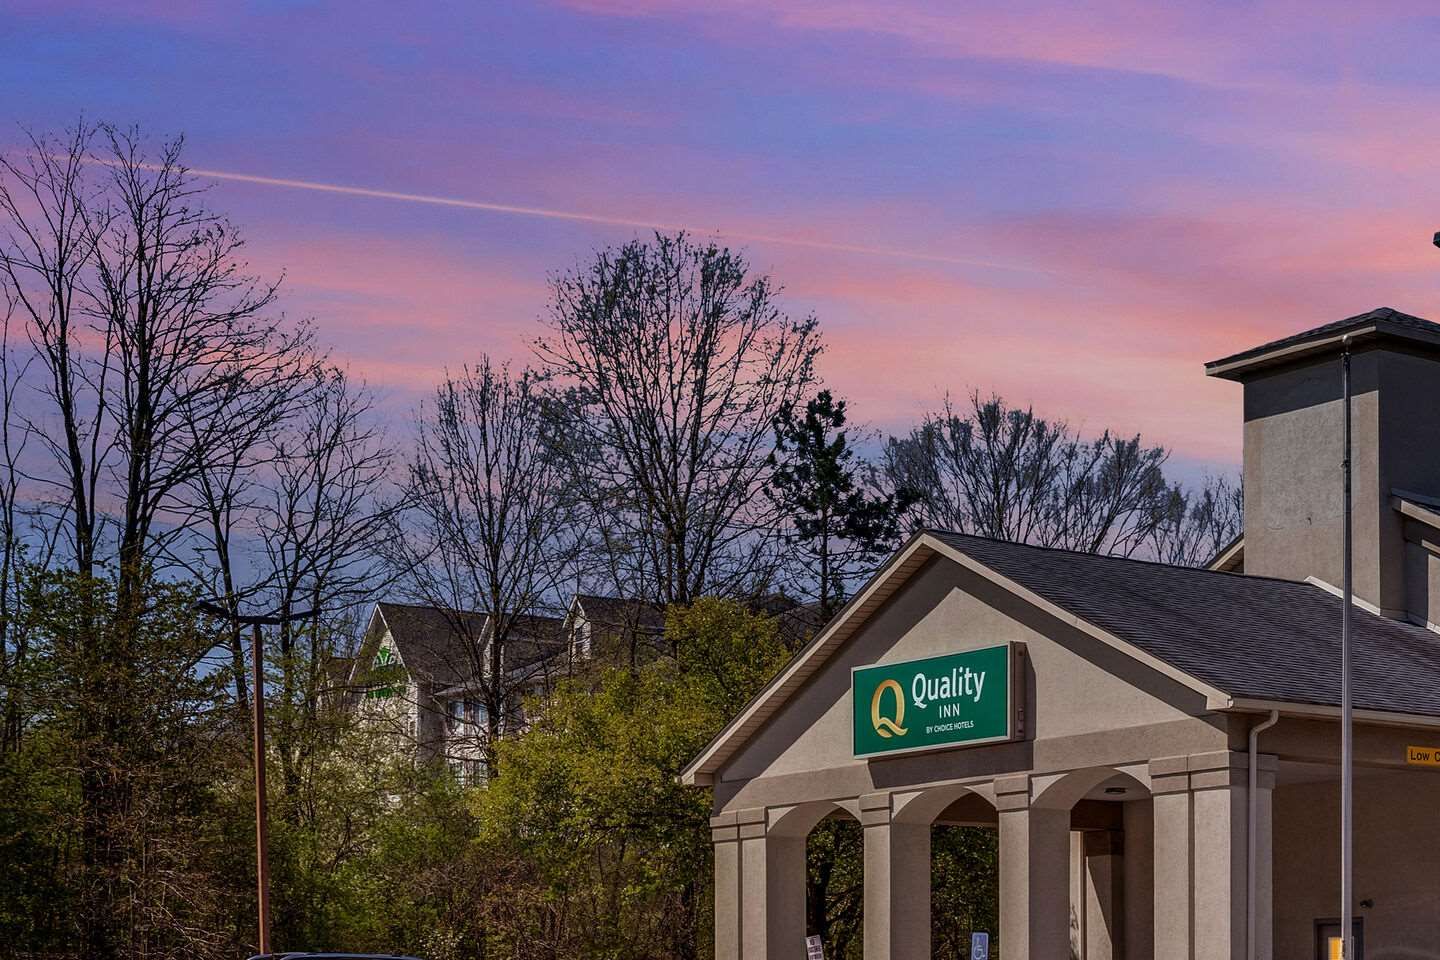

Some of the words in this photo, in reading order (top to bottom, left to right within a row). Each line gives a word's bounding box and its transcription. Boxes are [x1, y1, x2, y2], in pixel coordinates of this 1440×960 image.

[911, 666, 986, 709] Quality
[871, 679, 909, 738] Q
[938, 703, 961, 719] INN
[926, 726, 934, 734] BY
[934, 723, 954, 733] CHOICE
[953, 720, 975, 730] HOTELS
[1410, 749, 1430, 761] Low
